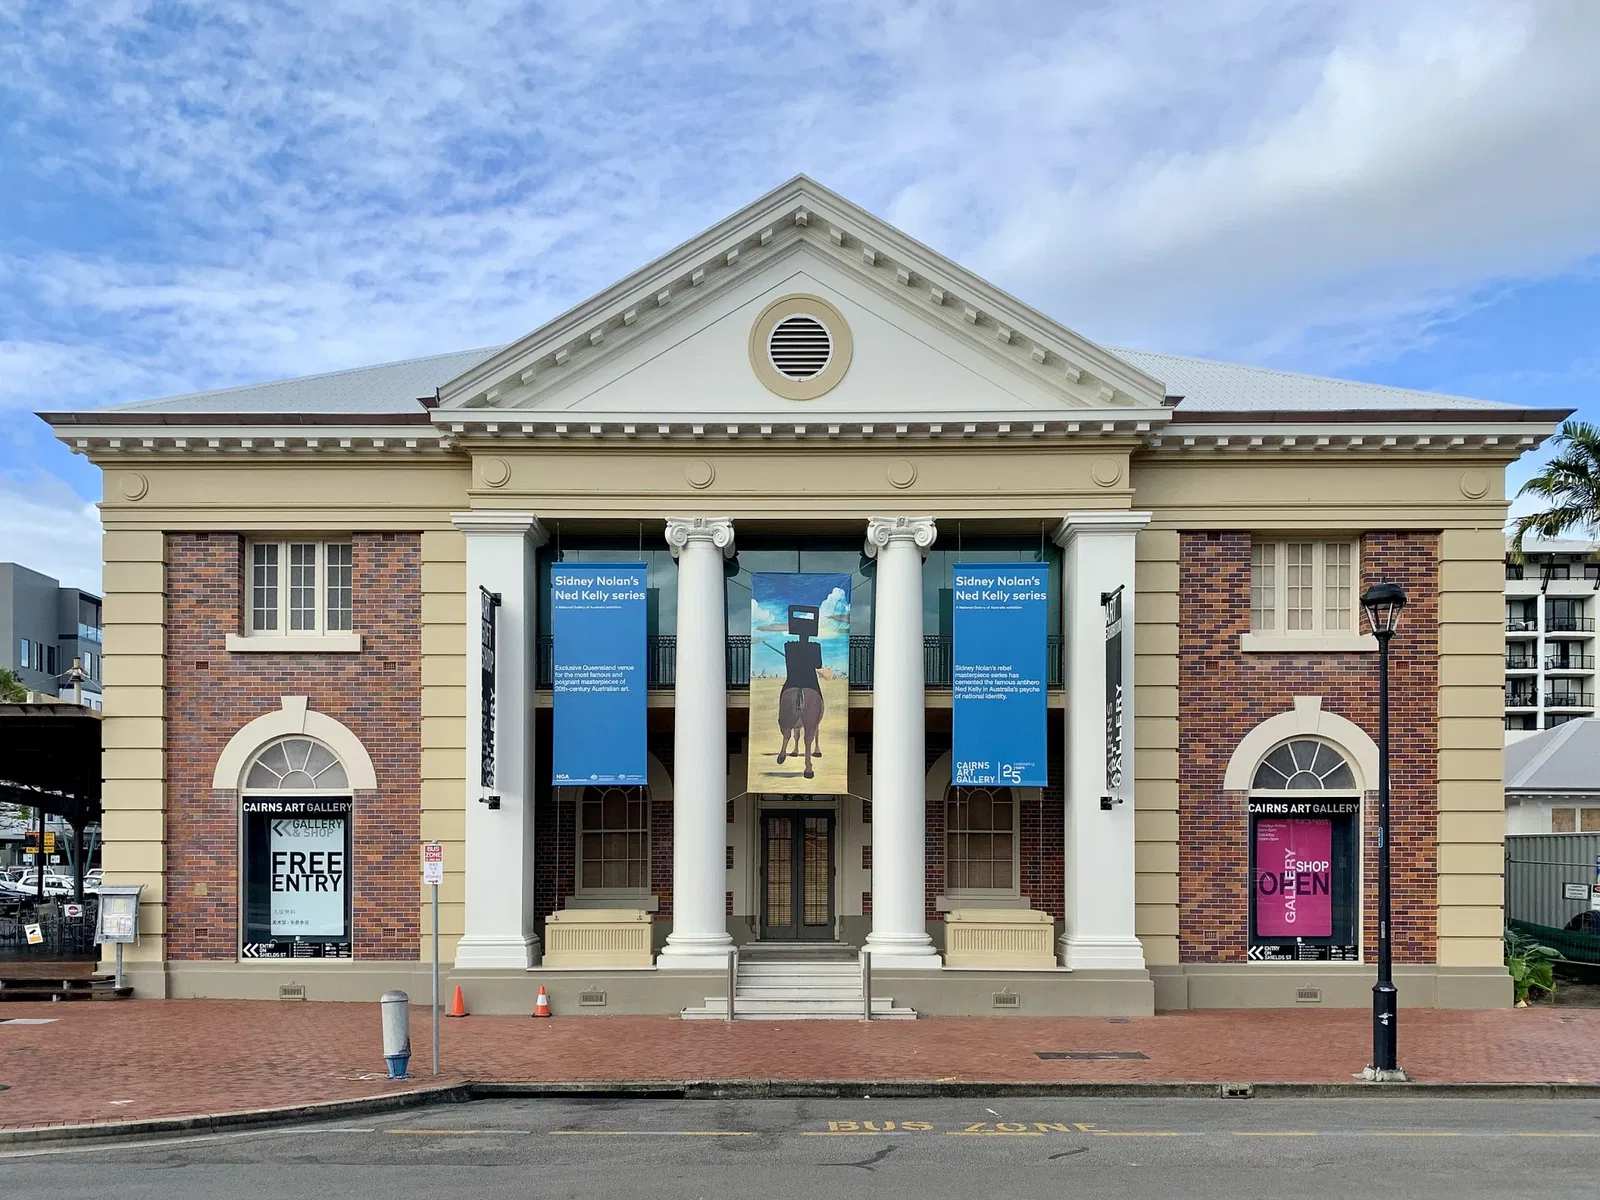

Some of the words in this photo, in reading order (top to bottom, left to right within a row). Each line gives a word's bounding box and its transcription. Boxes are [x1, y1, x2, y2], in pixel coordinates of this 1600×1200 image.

[555, 576, 594, 588] Sidney
[597, 576, 639, 586] Nolan's
[956, 576, 994, 588] Sidney
[997, 576, 1040, 586] Nolan's
[555, 590, 578, 600] Ned
[582, 590, 609, 602] Kelly
[612, 590, 645, 600] series
[956, 590, 979, 601] Ned
[982, 590, 1010, 602] Kelly
[1012, 590, 1047, 601] series
[1019, 686, 1040, 694] psyche
[957, 761, 990, 769] CAIRNS
[243, 802, 283, 813] CAIRNS
[284, 802, 306, 813] ART
[307, 802, 353, 813] GALLERY
[1248, 803, 1288, 813] CAIRNS
[1290, 803, 1311, 813] ART
[1312, 803, 1360, 813] GALLERY
[292, 820, 342, 829] GALLERY
[292, 828, 301, 838] &
[303, 828, 334, 838] SHOP
[272, 851, 343, 874] FREE
[1296, 860, 1330, 872] SHOP
[272, 874, 342, 892] ENTRY
[1284, 848, 1296, 924] GALLERY
[827, 1120, 935, 1132] BUS
[963, 1121, 1110, 1133] ZONE
